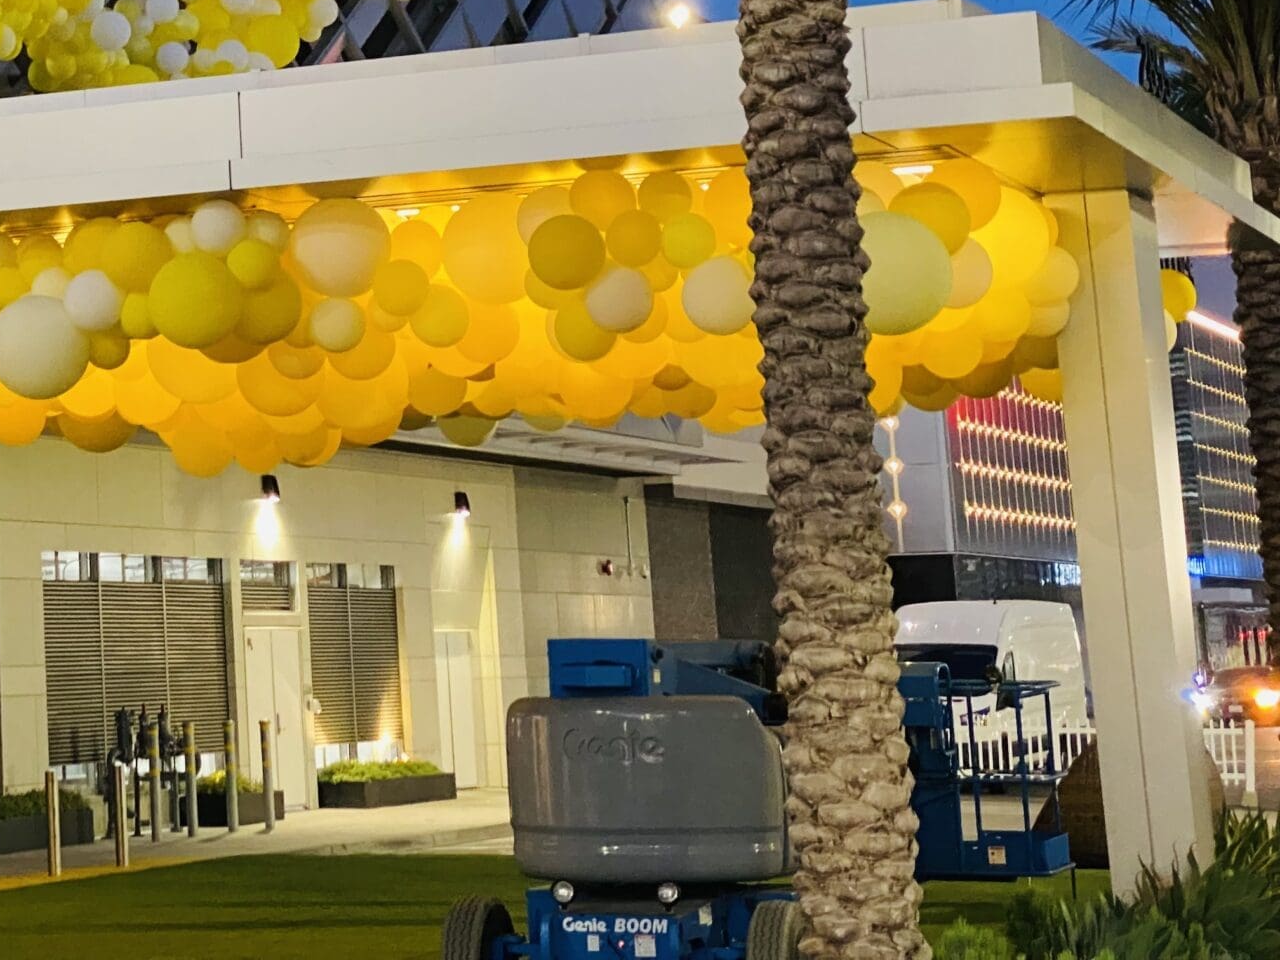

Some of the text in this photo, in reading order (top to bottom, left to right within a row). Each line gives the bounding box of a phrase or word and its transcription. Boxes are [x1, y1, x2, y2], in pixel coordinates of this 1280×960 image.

[561, 725, 665, 764] Genie
[562, 917, 668, 933] Genie BOOM
